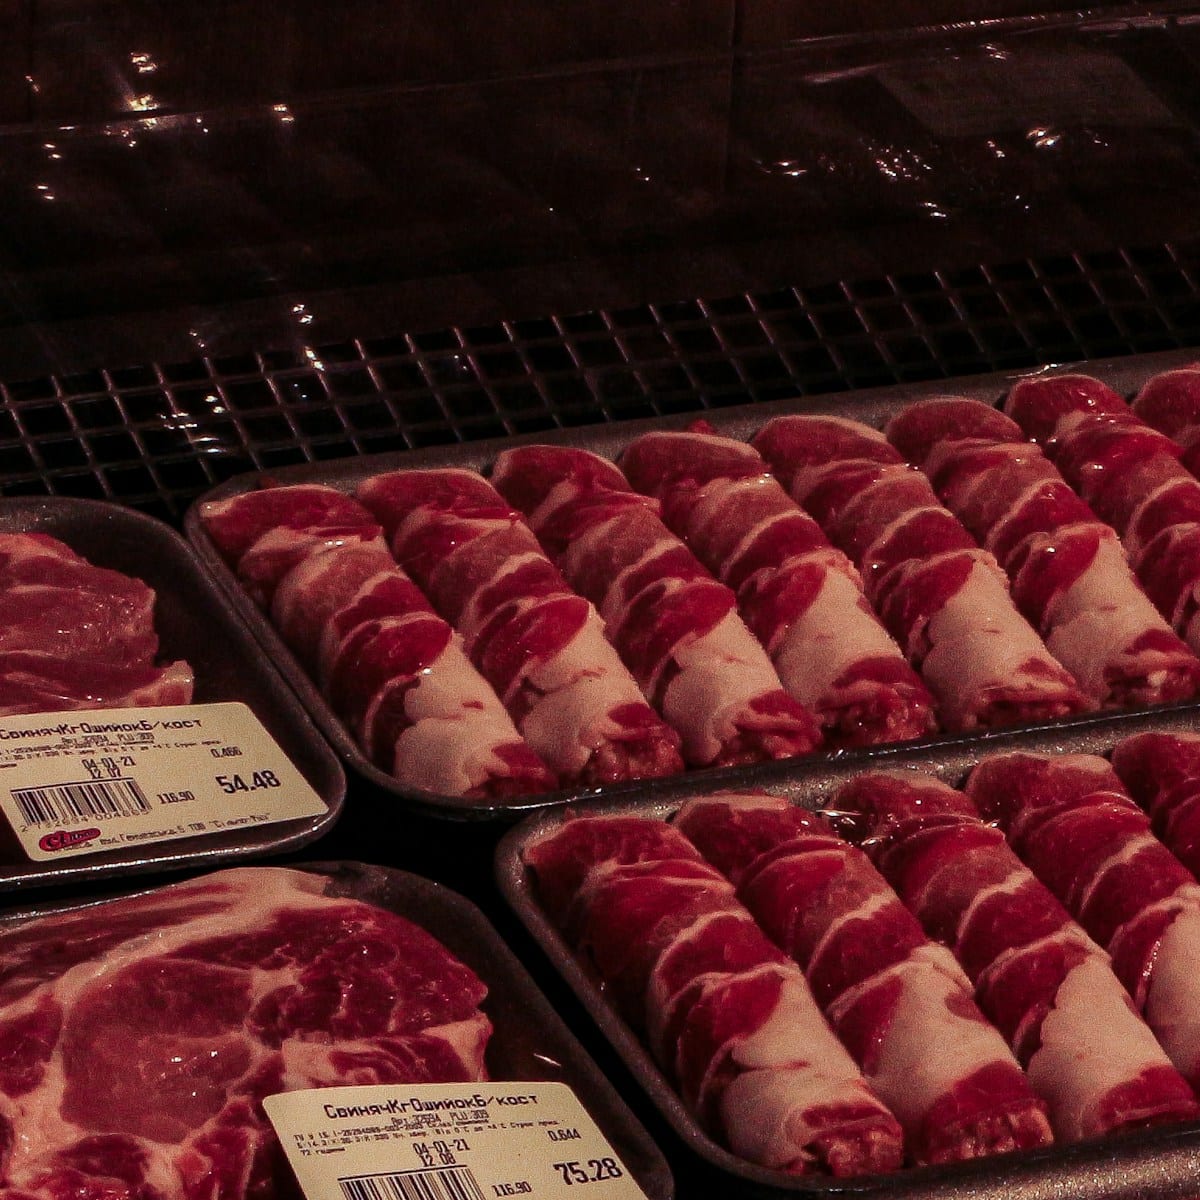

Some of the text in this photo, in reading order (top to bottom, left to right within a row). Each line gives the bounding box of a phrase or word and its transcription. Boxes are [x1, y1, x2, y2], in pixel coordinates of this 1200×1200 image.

[82, 756, 136, 769] 04-01-21
[215, 770, 281, 794] 54.48
[156, 791, 195, 804] 116.90
[547, 1128, 581, 1141] 0.644
[413, 1139, 470, 1156] 04-01-21
[553, 1157, 623, 1185] 75.28
[491, 1181, 532, 1197] 116.90
